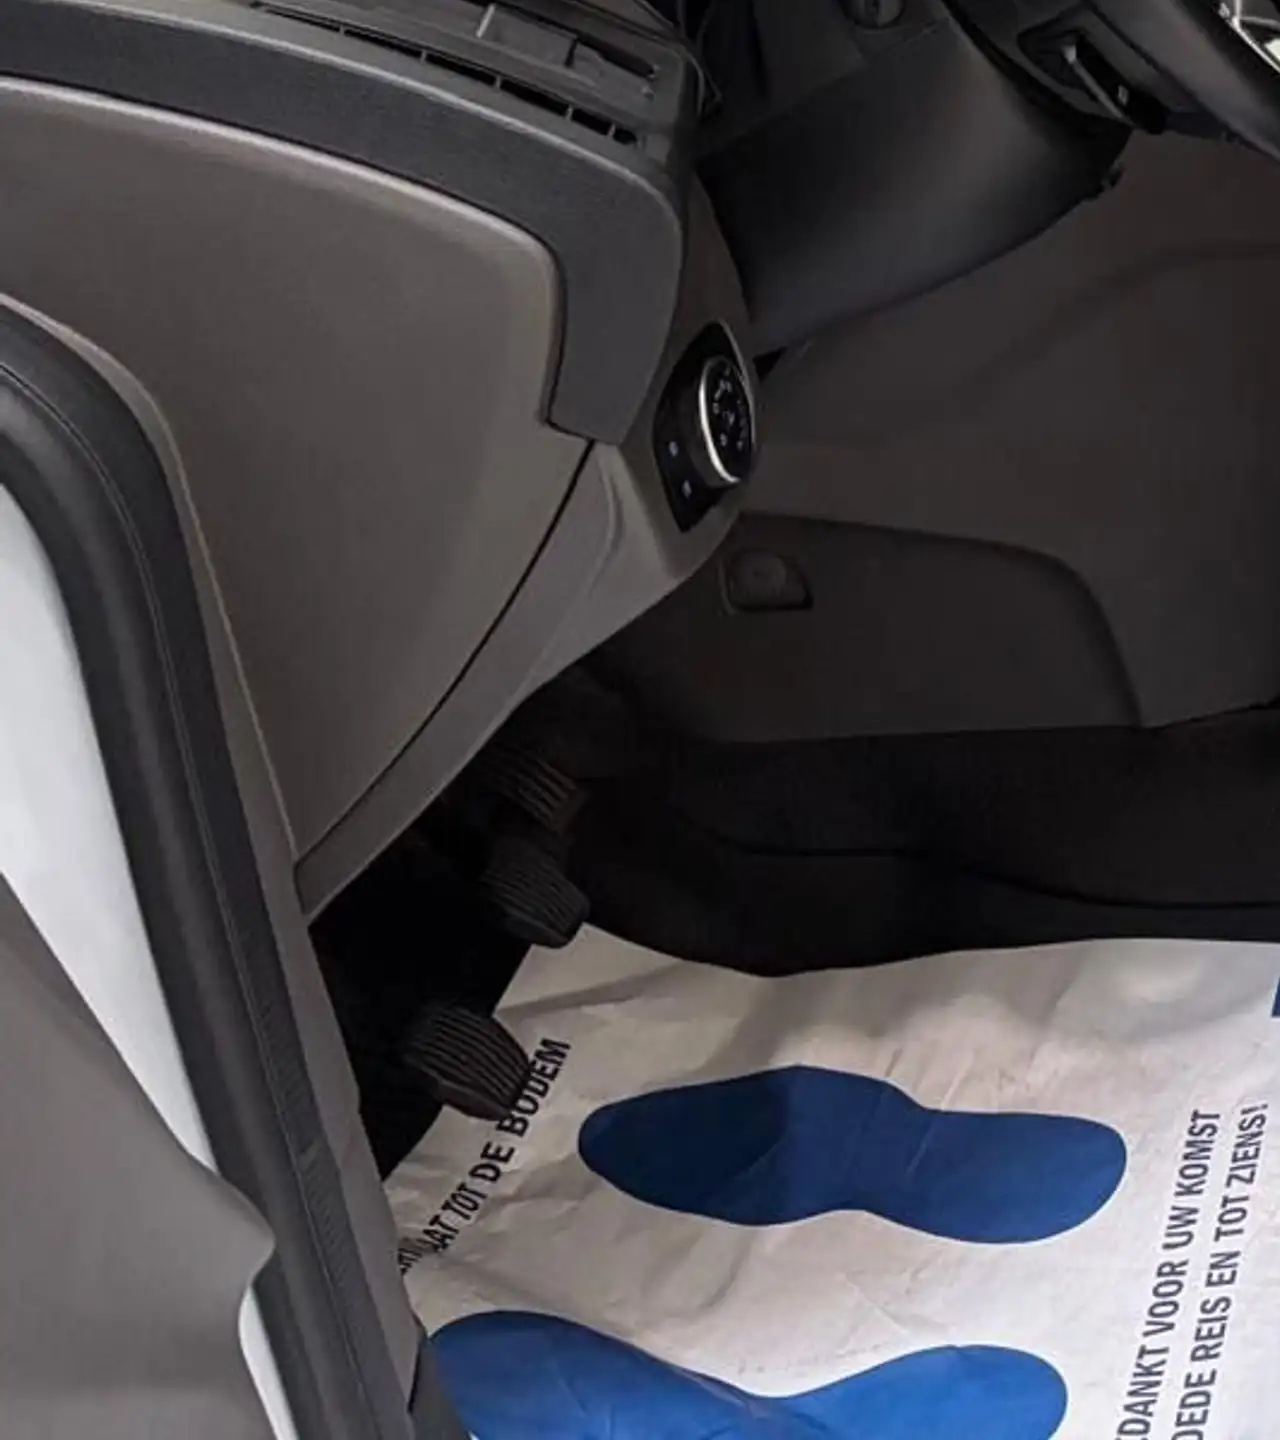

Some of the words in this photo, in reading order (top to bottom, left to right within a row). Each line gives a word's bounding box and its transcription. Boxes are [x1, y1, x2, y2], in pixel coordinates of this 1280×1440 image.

[442, 1182, 488, 1220] TOT
[468, 1142, 515, 1183] DE
[495, 1038, 572, 1138] BODEM
[1174, 1109, 1220, 1197] KOMST
[1225, 1103, 1268, 1188] ZIENS!
[1162, 1205, 1199, 1250] UW
[1213, 1195, 1250, 1242] TOT
[1142, 1259, 1190, 1337] VOOR
[1205, 1250, 1241, 1287] EN
[1190, 1295, 1232, 1362] REIS
[1114, 1344, 1169, 1440] DANKT
